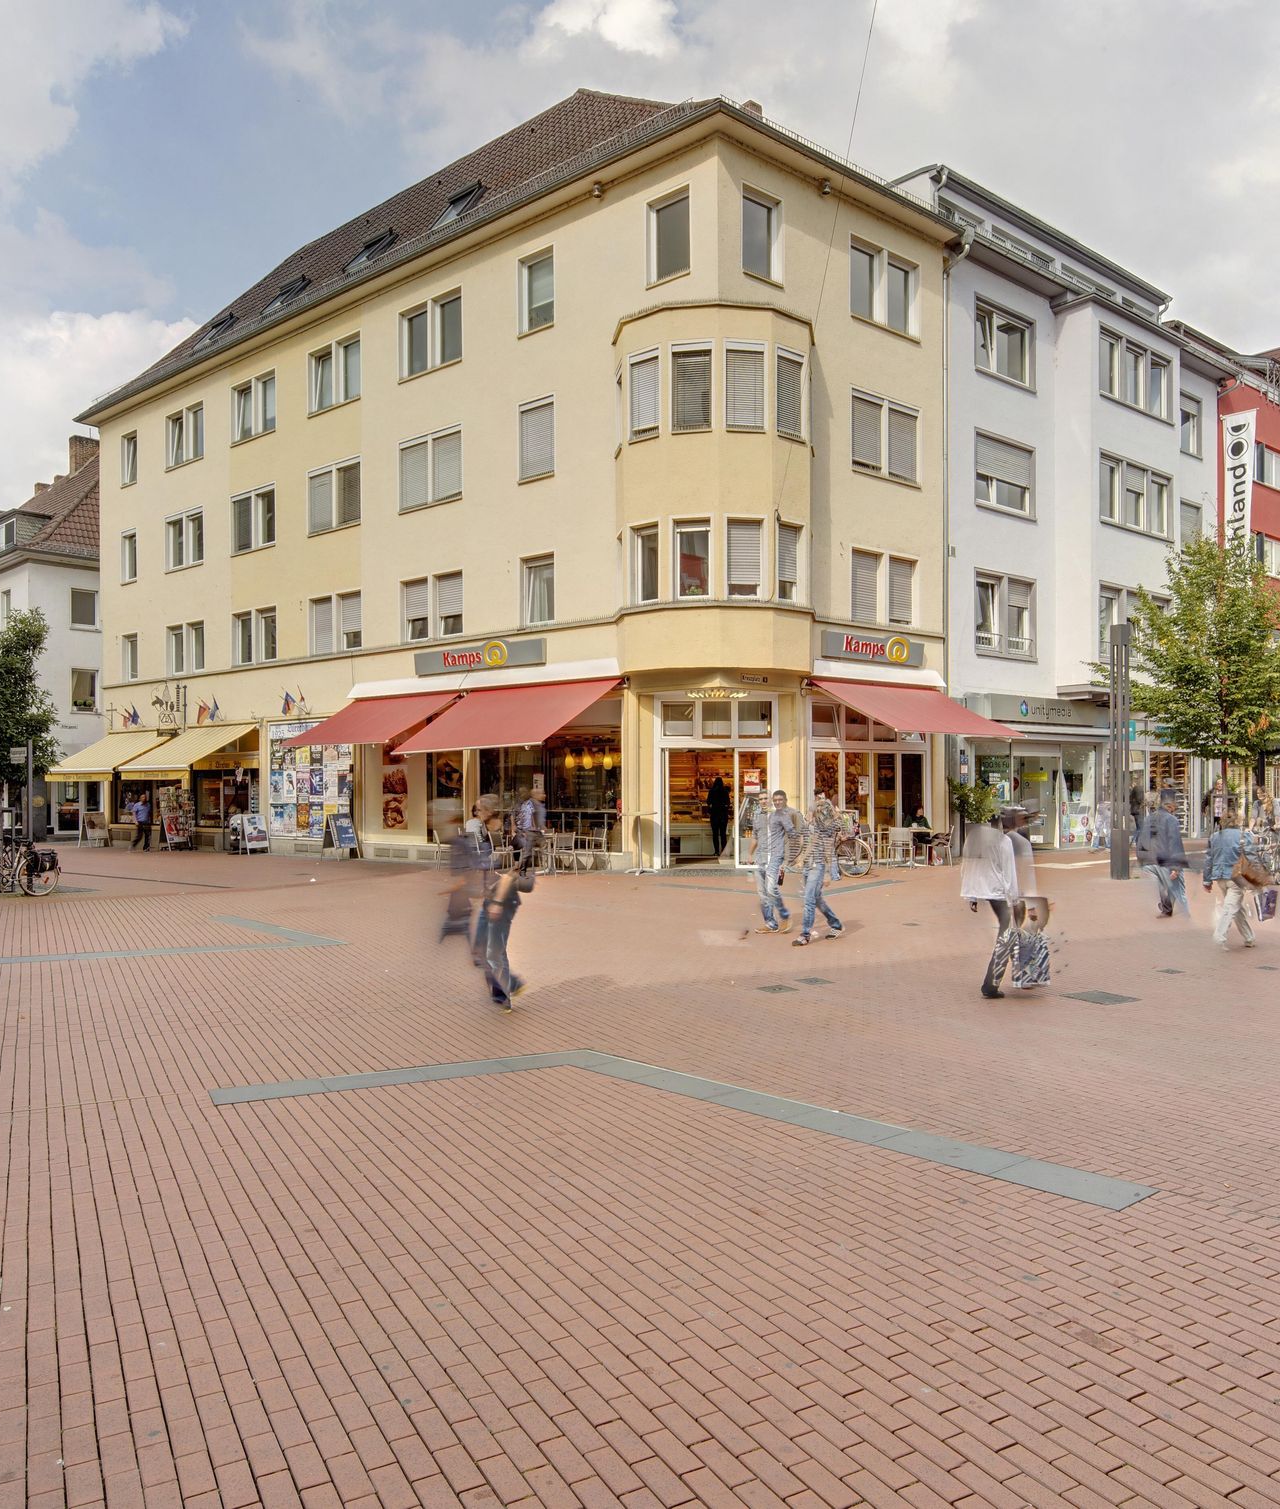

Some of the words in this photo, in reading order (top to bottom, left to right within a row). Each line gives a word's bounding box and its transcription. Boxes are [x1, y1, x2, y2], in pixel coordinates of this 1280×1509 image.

[842, 634, 885, 659] Kamps
[442, 651, 482, 669] Kamps
[1030, 704, 1072, 720] unitymedia
